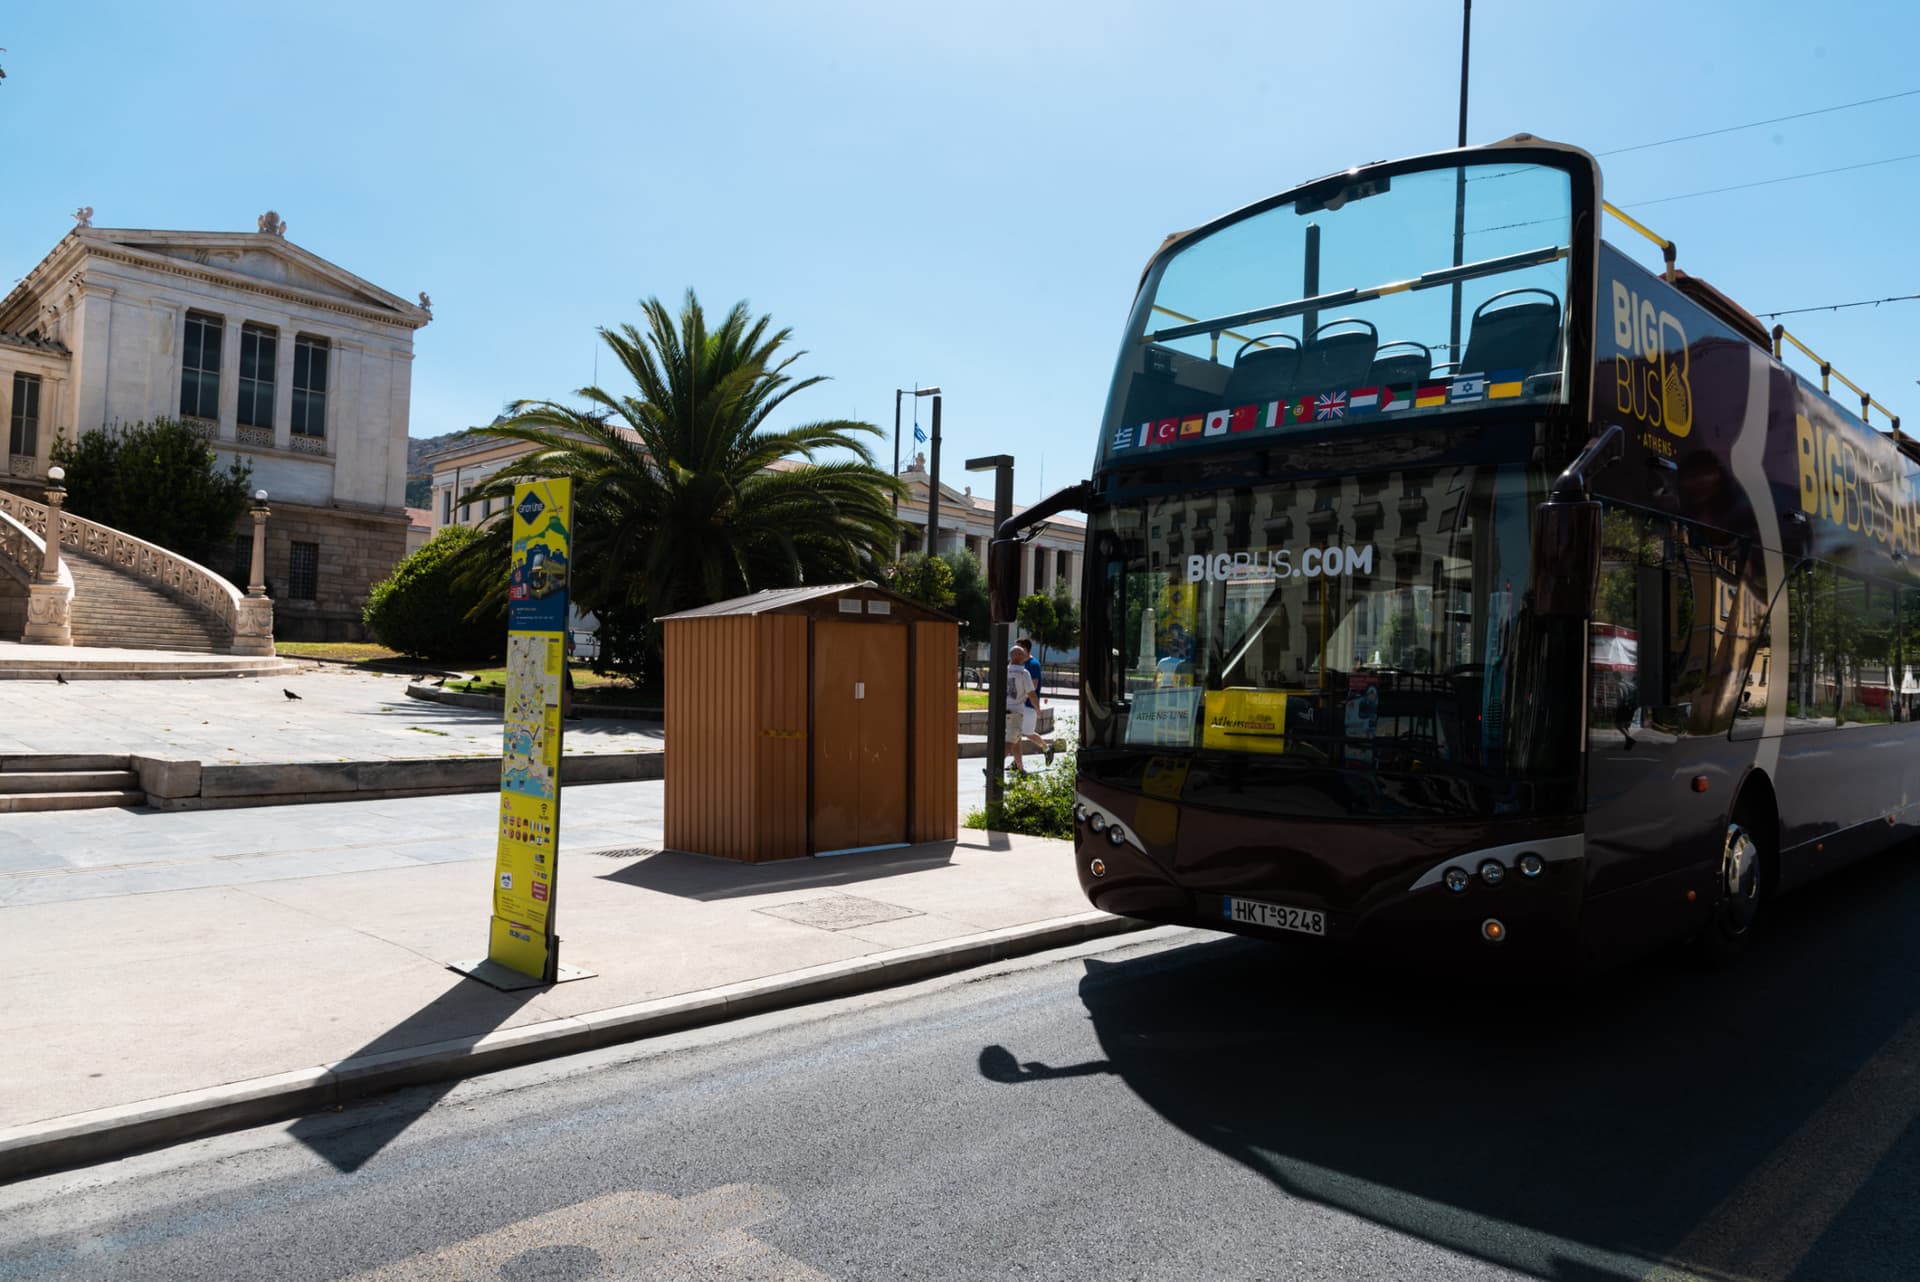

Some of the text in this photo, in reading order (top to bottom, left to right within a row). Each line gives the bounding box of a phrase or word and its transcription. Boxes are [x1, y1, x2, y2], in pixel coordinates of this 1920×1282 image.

[1612, 279, 1658, 364] BIG
[1616, 352, 1662, 427] BUS
[1643, 432, 1673, 457] ATHENS
[1187, 544, 1373, 582] BIGBUS.COM
[1136, 711, 1169, 721] ATHENS
